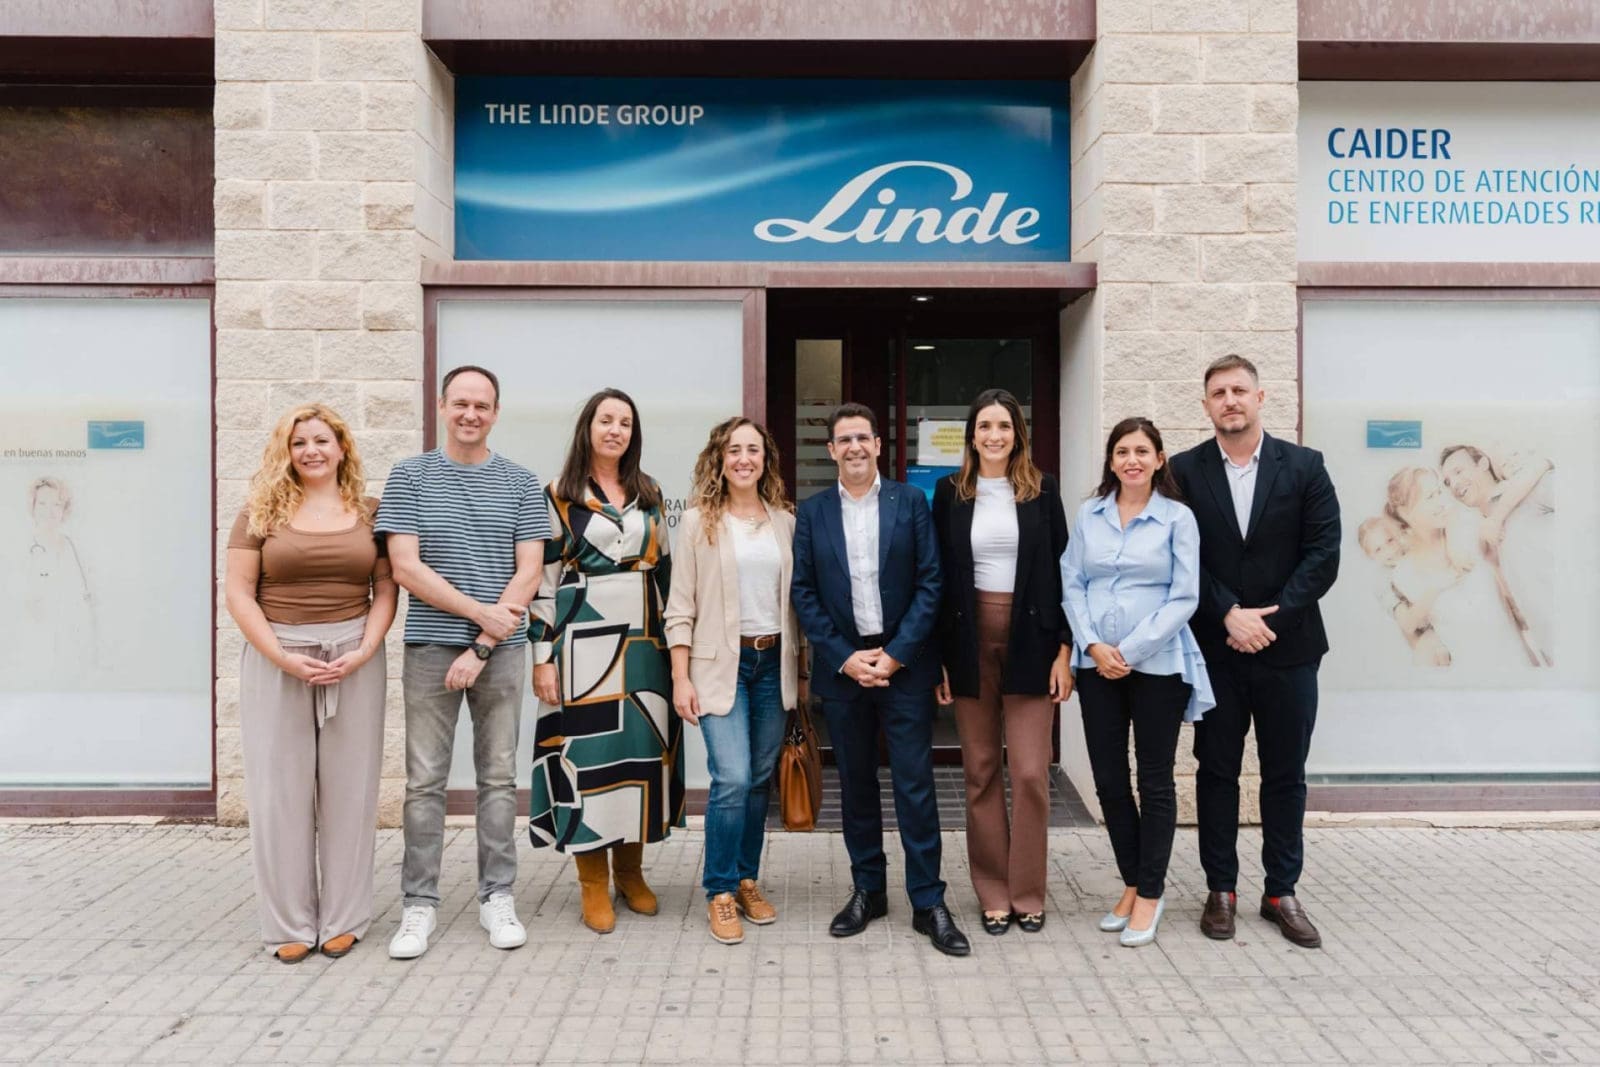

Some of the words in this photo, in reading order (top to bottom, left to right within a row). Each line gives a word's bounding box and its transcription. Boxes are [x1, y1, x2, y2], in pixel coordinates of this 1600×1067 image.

[485, 104, 531, 125] THE
[540, 105, 610, 126] LINDE
[616, 105, 705, 127] GROUP
[1327, 127, 1452, 160] CAIDER
[1328, 169, 1425, 193] CENTRO
[1435, 169, 1466, 193] DE
[1475, 164, 1599, 193] ATENCIÓN
[753, 160, 1041, 246] Linde
[1328, 201, 1359, 224] DE
[1369, 201, 1570, 224] ENFERMEDADES
[1580, 201, 1600, 224] R
[4, 449, 16, 457] en
[19, 447, 53, 457] buenas
[55, 449, 87, 457] manos
